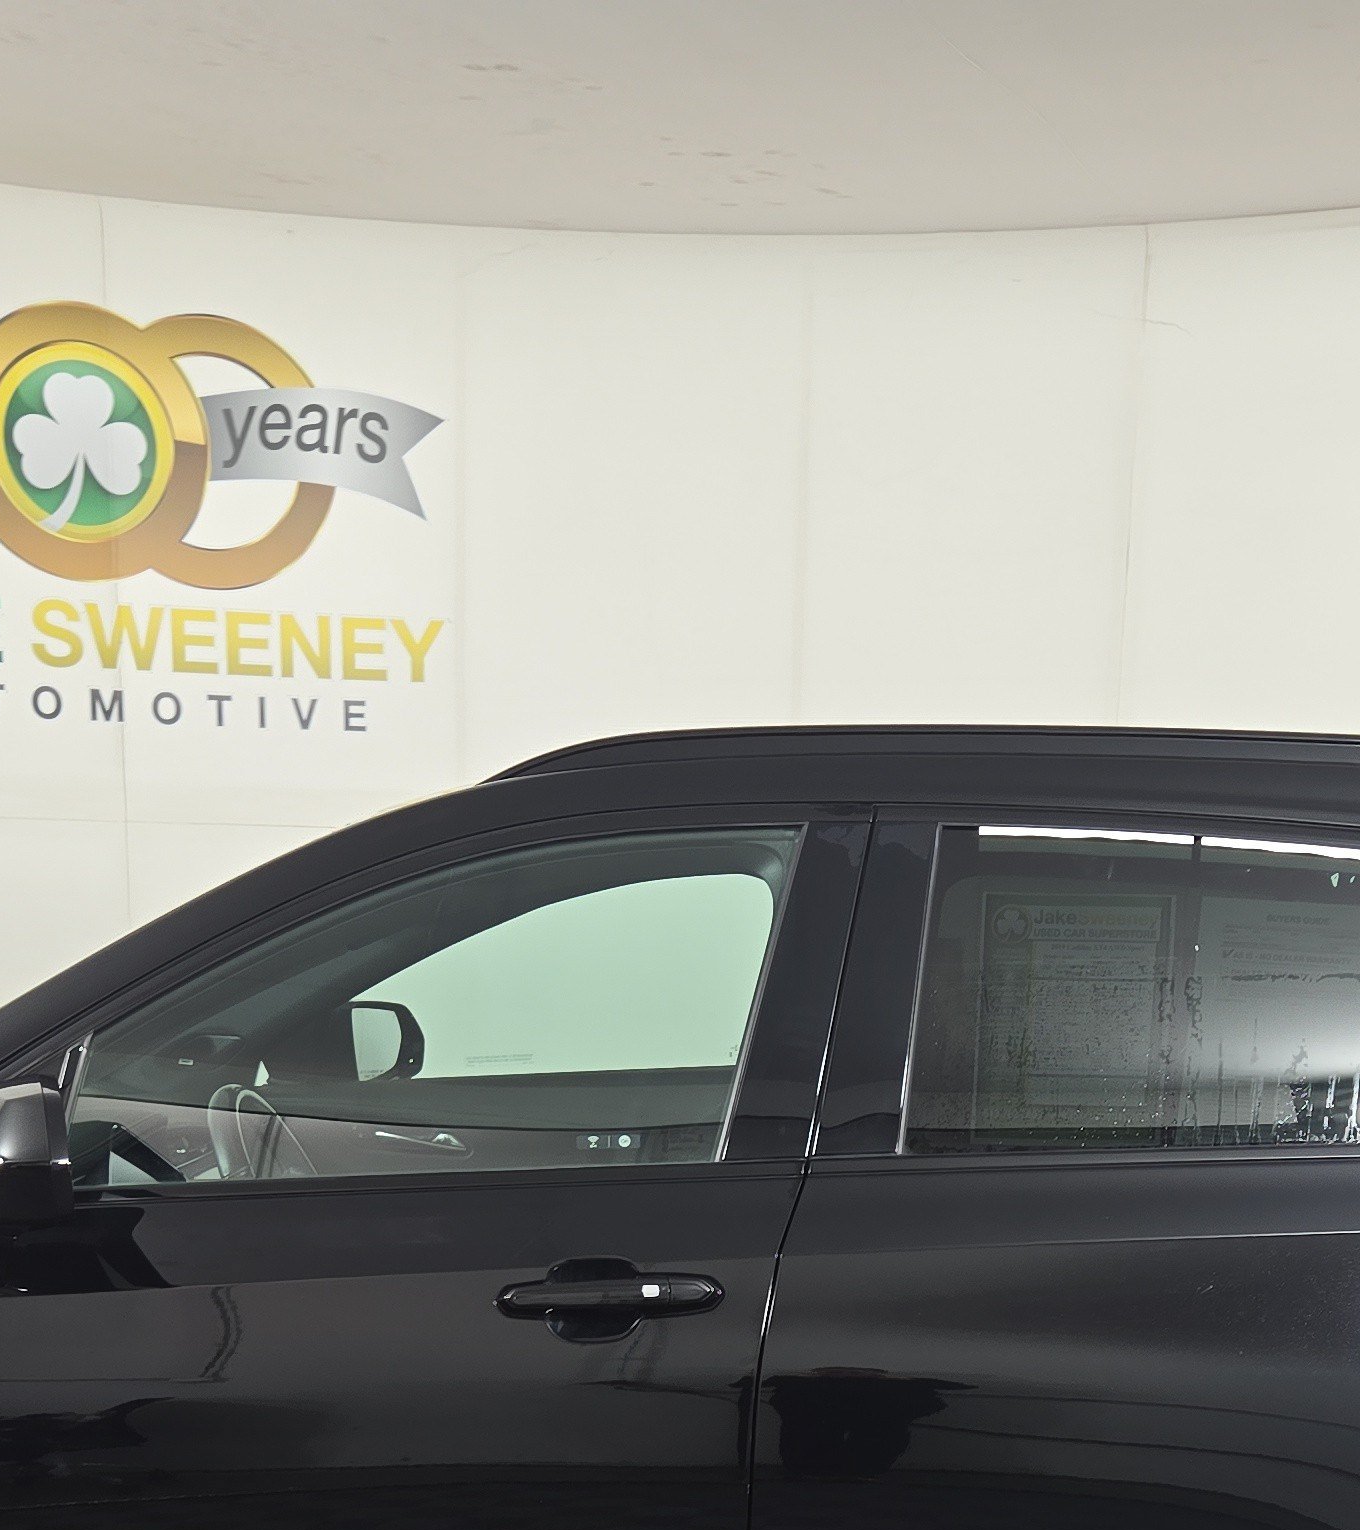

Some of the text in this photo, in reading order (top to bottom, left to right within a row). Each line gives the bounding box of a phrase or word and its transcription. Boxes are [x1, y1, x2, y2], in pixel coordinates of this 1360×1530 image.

[221, 402, 390, 470] years
[30, 598, 445, 684] SWEENEY
[1063, 928, 1086, 938] CAR
